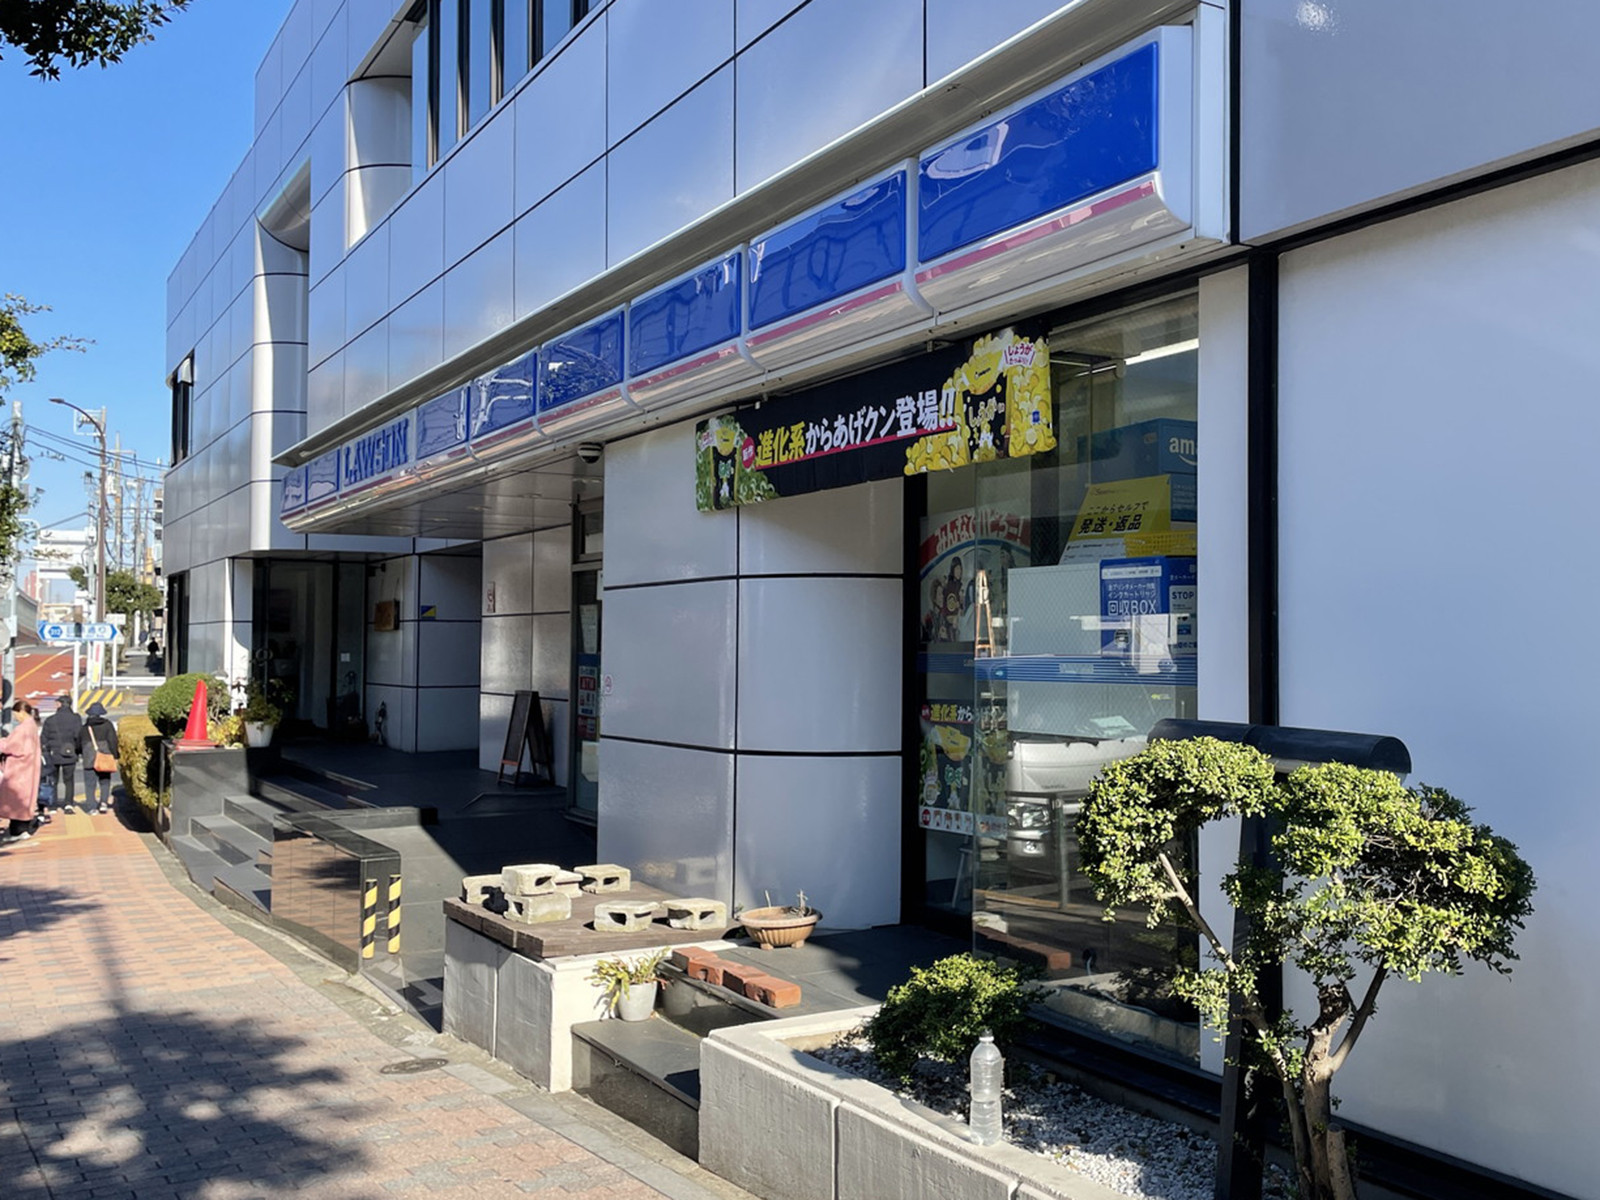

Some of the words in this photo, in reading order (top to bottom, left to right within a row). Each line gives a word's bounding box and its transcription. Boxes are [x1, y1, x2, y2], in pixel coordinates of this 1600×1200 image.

[1169, 437, 1197, 456] am
[1079, 513, 1142, 534] 発送・返品
[1171, 591, 1195, 600] STOP
[1108, 599, 1157, 616] 回収BOX
